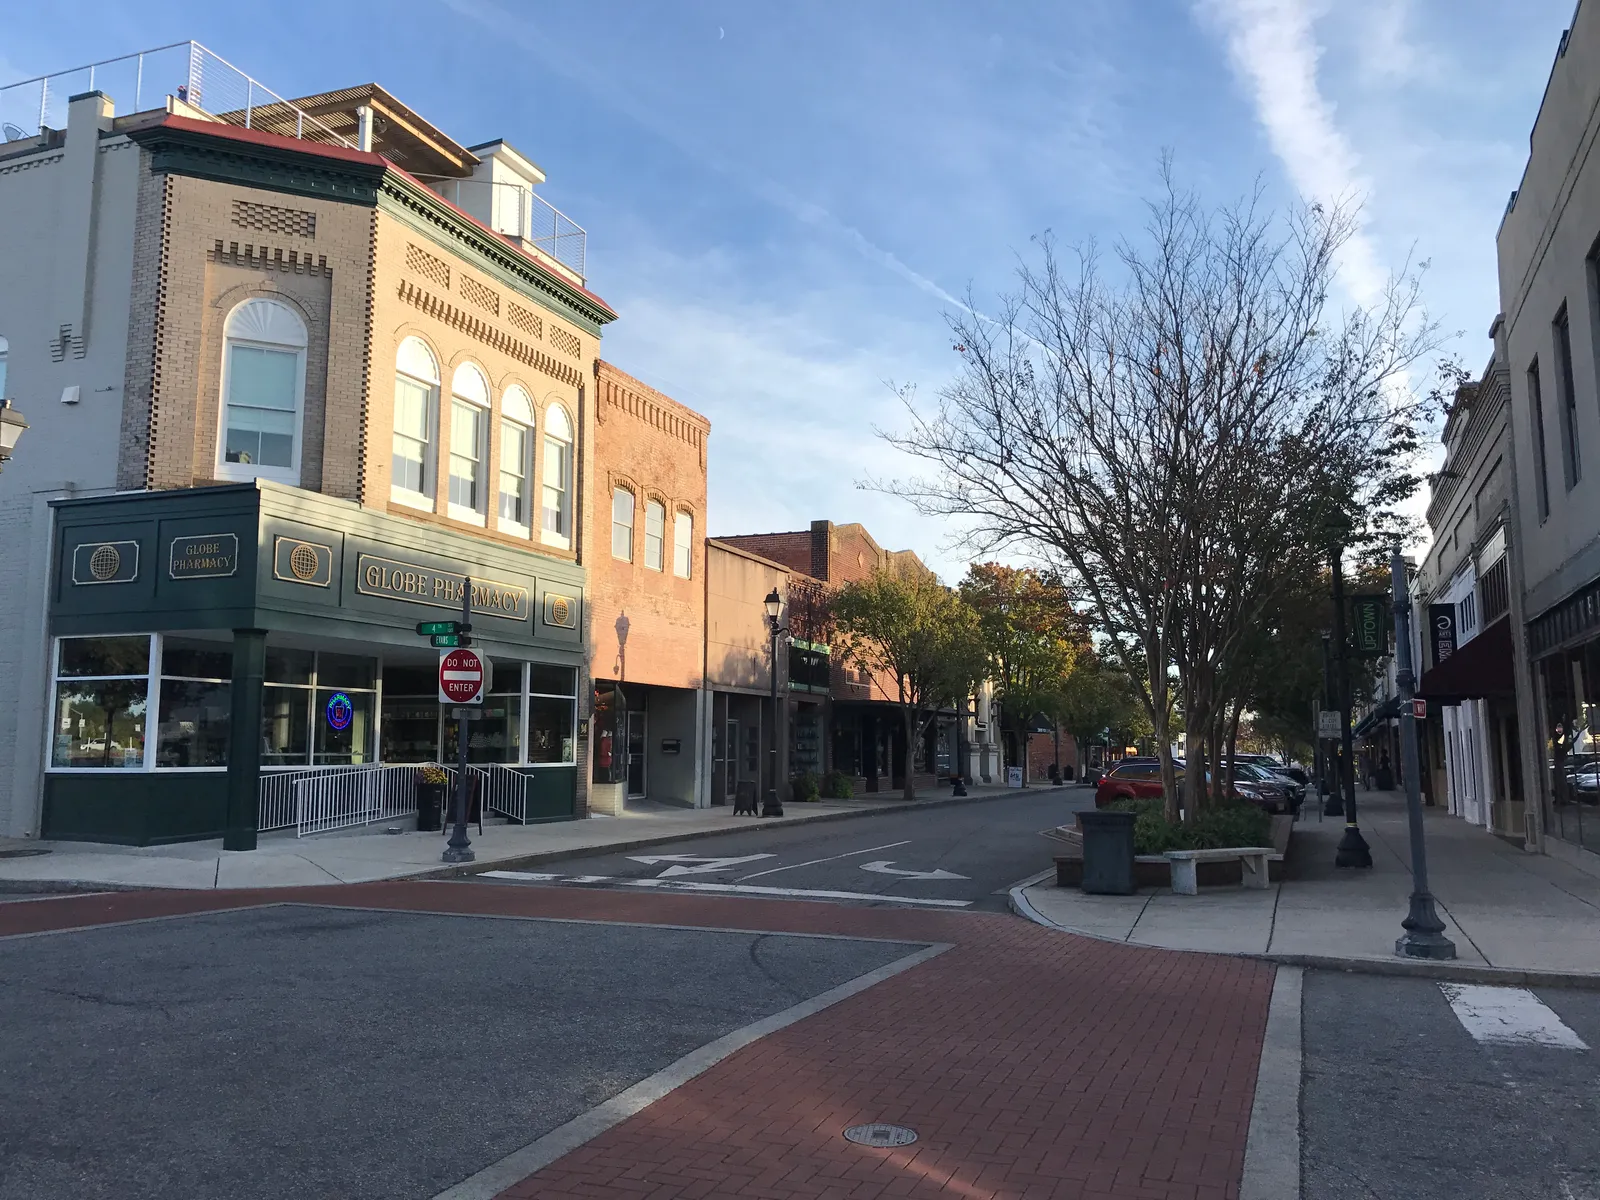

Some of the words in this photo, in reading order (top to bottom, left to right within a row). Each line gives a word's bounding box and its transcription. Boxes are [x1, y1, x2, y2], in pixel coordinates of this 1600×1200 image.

[185, 543, 220, 556] GLOBE
[173, 554, 232, 571] PHARMACY
[365, 565, 428, 596] GLOBE
[432, 577, 523, 612] PHARMACY
[431, 624, 436, 633] 4
[1363, 603, 1377, 650] UPTOWN
[435, 635, 449, 645] EVANS
[447, 658, 458, 667] DO
[462, 659, 478, 668] NOT
[449, 682, 474, 692] ENTER
[328, 693, 351, 710] PHARMACY
